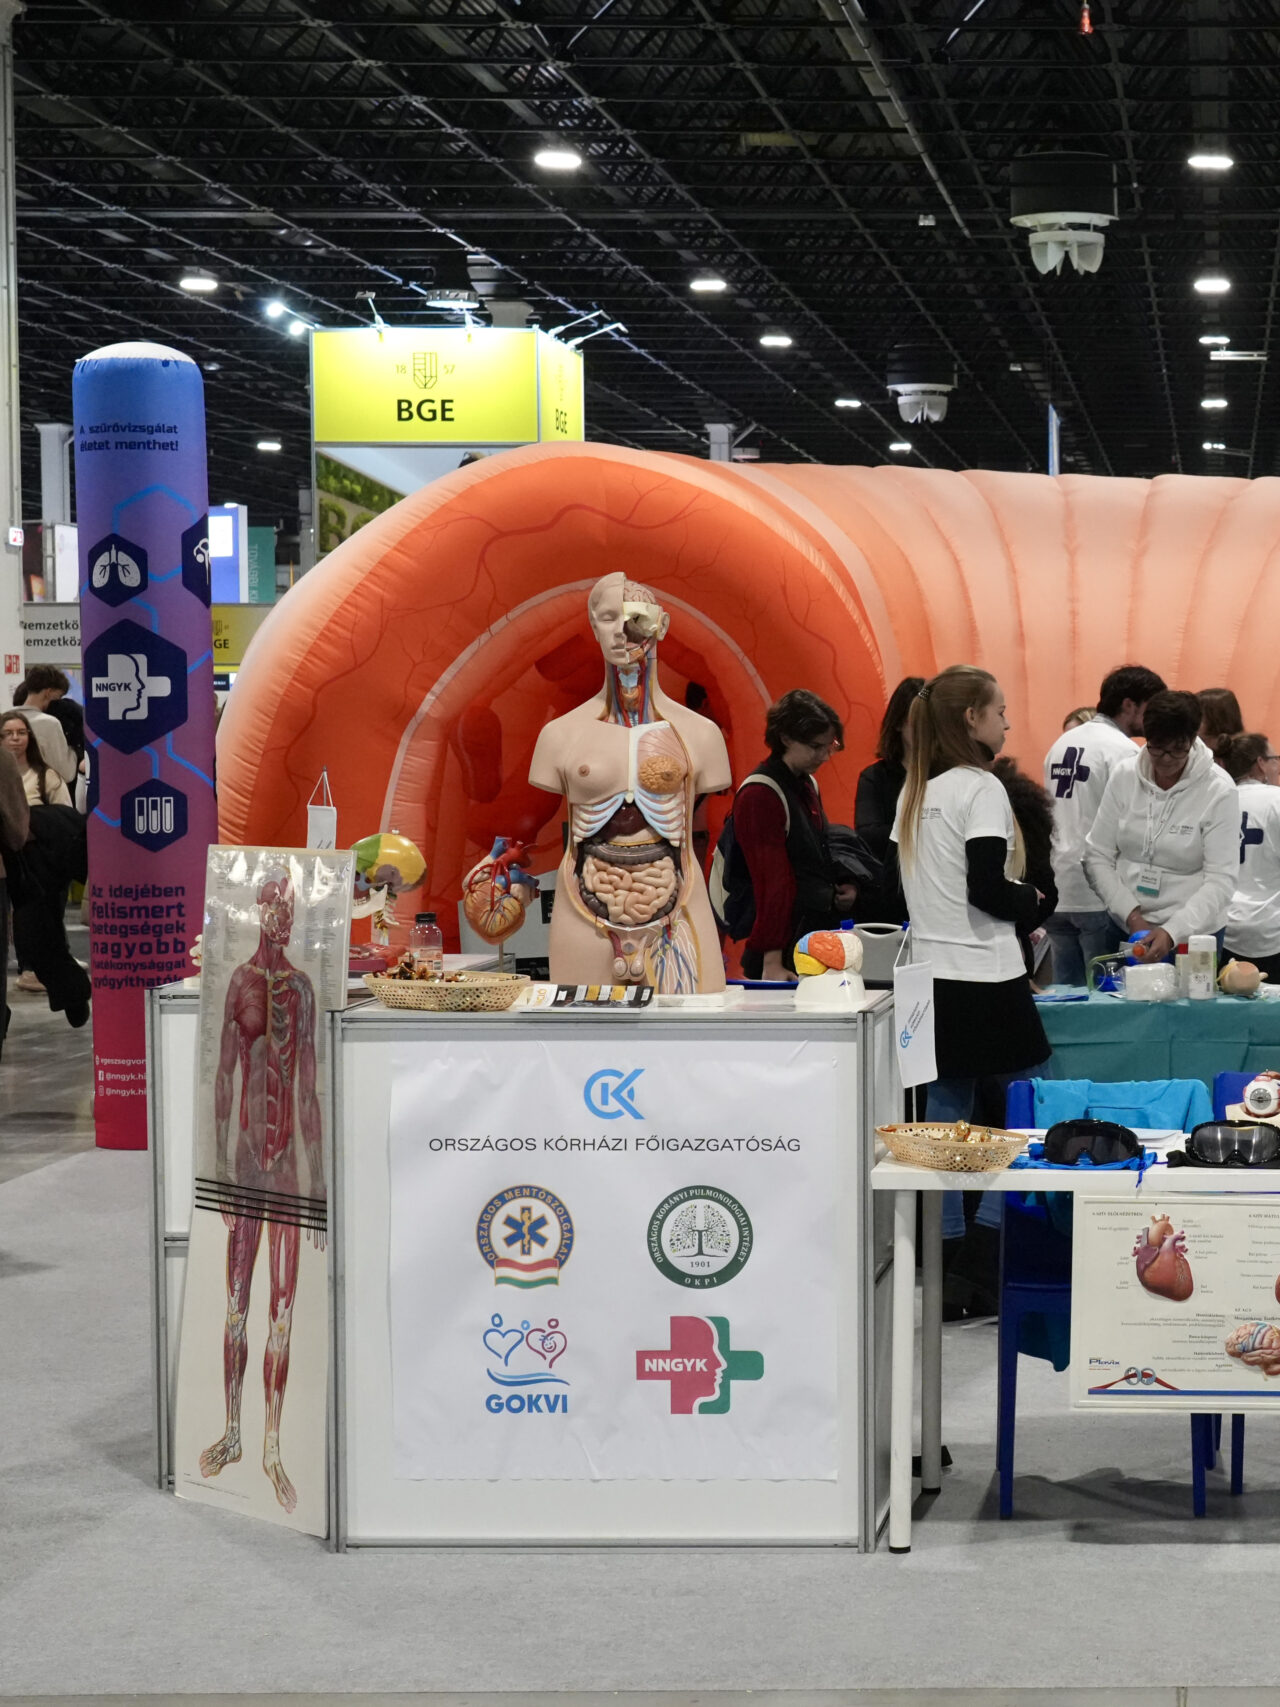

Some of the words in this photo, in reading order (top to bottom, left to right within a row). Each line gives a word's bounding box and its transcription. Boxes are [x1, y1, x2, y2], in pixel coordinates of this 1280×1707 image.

[395, 364, 407, 375] 18
[443, 364, 455, 375] 57
[397, 399, 455, 422] BGE
[80, 424, 85, 434] A
[89, 422, 178, 434] szűrővizsgálat
[555, 408, 568, 434] BGE
[80, 440, 111, 452] életet
[115, 439, 178, 451] menthet!
[213, 638, 230, 649] GE
[95, 682, 131, 692] NNGYK
[1052, 767, 1071, 776] NNGYK
[92, 885, 103, 898] Az
[109, 884, 185, 901] idejében
[92, 902, 186, 919] felismert
[93, 938, 186, 959] nagyobb
[429, 1136, 537, 1152] ORSZÁGOS
[544, 1136, 627, 1152] KÓRHÁZI
[635, 1136, 801, 1152] FŐIGAZGATÓSÁG
[656, 1191, 688, 1219] KORÁNYI
[689, 1189, 748, 1226] PULMONOLÓGIAI
[480, 1199, 502, 1260] ORSZÁGOS
[650, 1219, 664, 1263] ORSZÁGOS
[737, 1226, 751, 1262] INTÉZET
[684, 1277, 717, 1286] OKPI
[644, 1358, 708, 1372] NNGYK
[1089, 1357, 1120, 1366] Plavix
[485, 1394, 568, 1414] GOKVI
